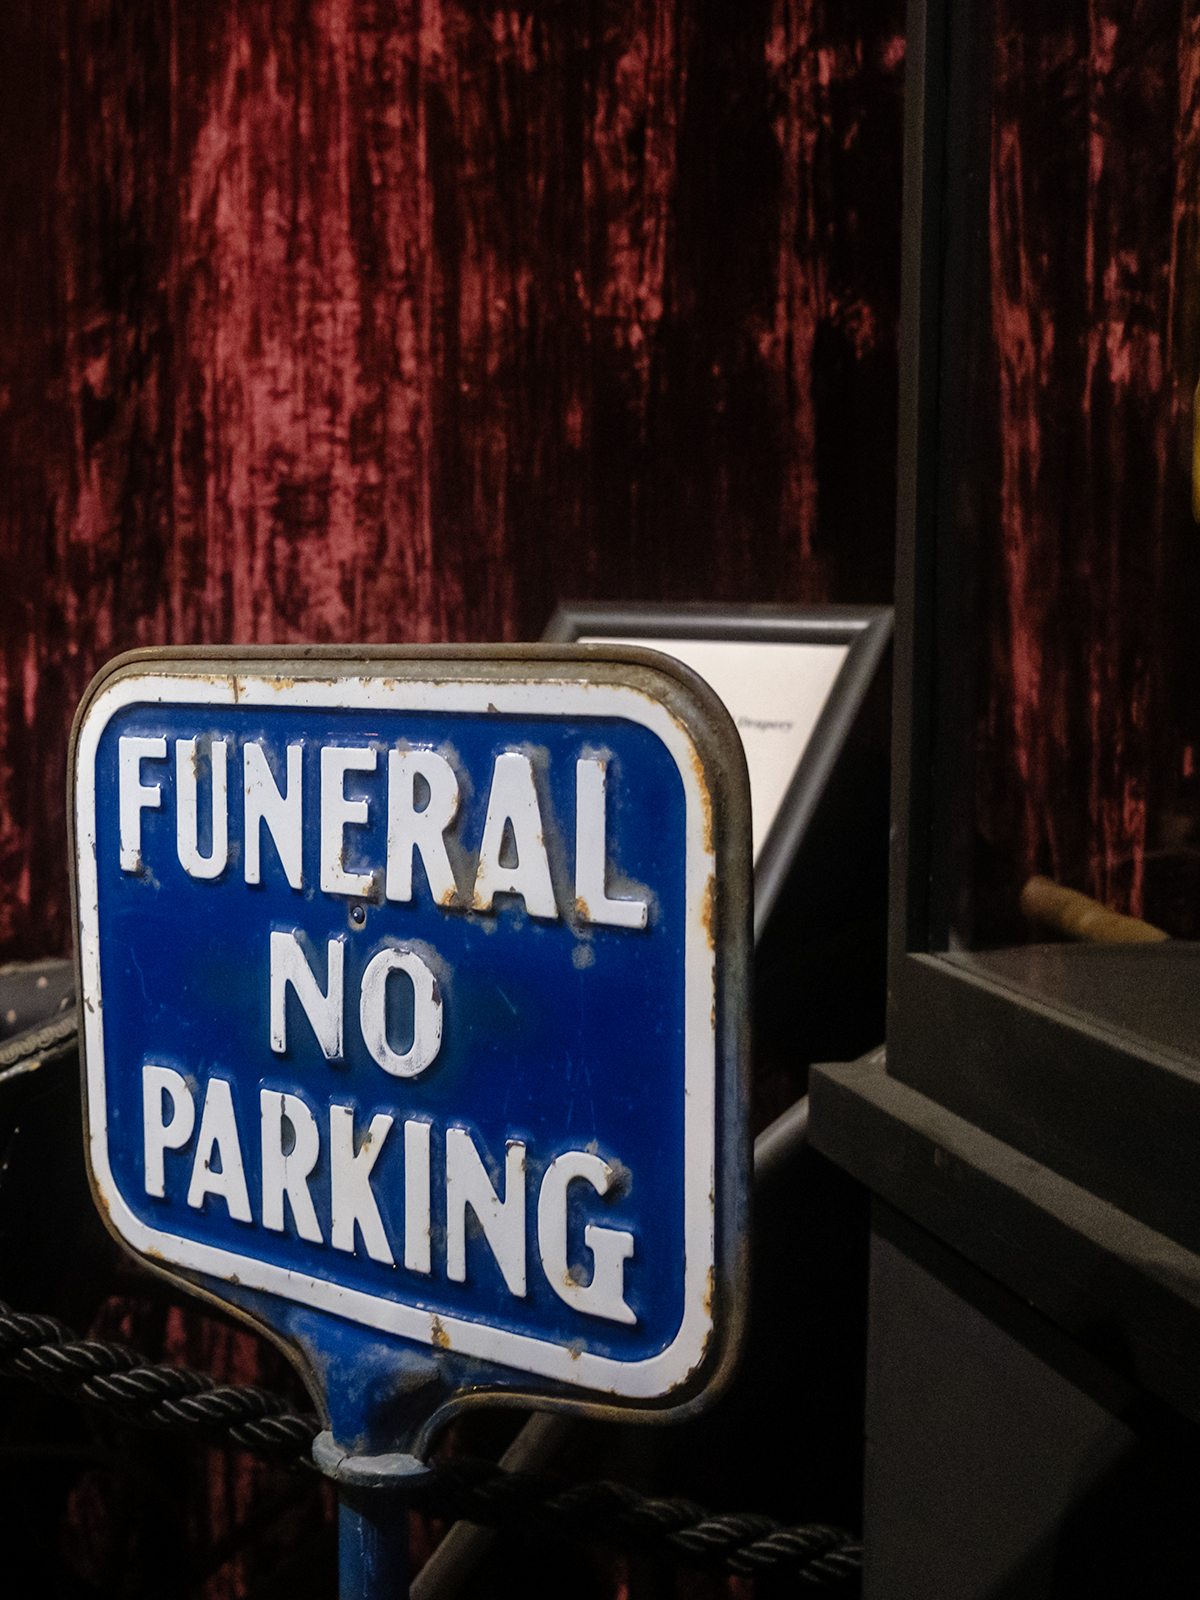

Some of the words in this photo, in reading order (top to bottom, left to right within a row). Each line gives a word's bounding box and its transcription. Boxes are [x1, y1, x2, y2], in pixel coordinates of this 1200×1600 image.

[119, 736, 648, 930] FUNERAL
[270, 931, 443, 1078] NO
[142, 1065, 638, 1325] PARKING
